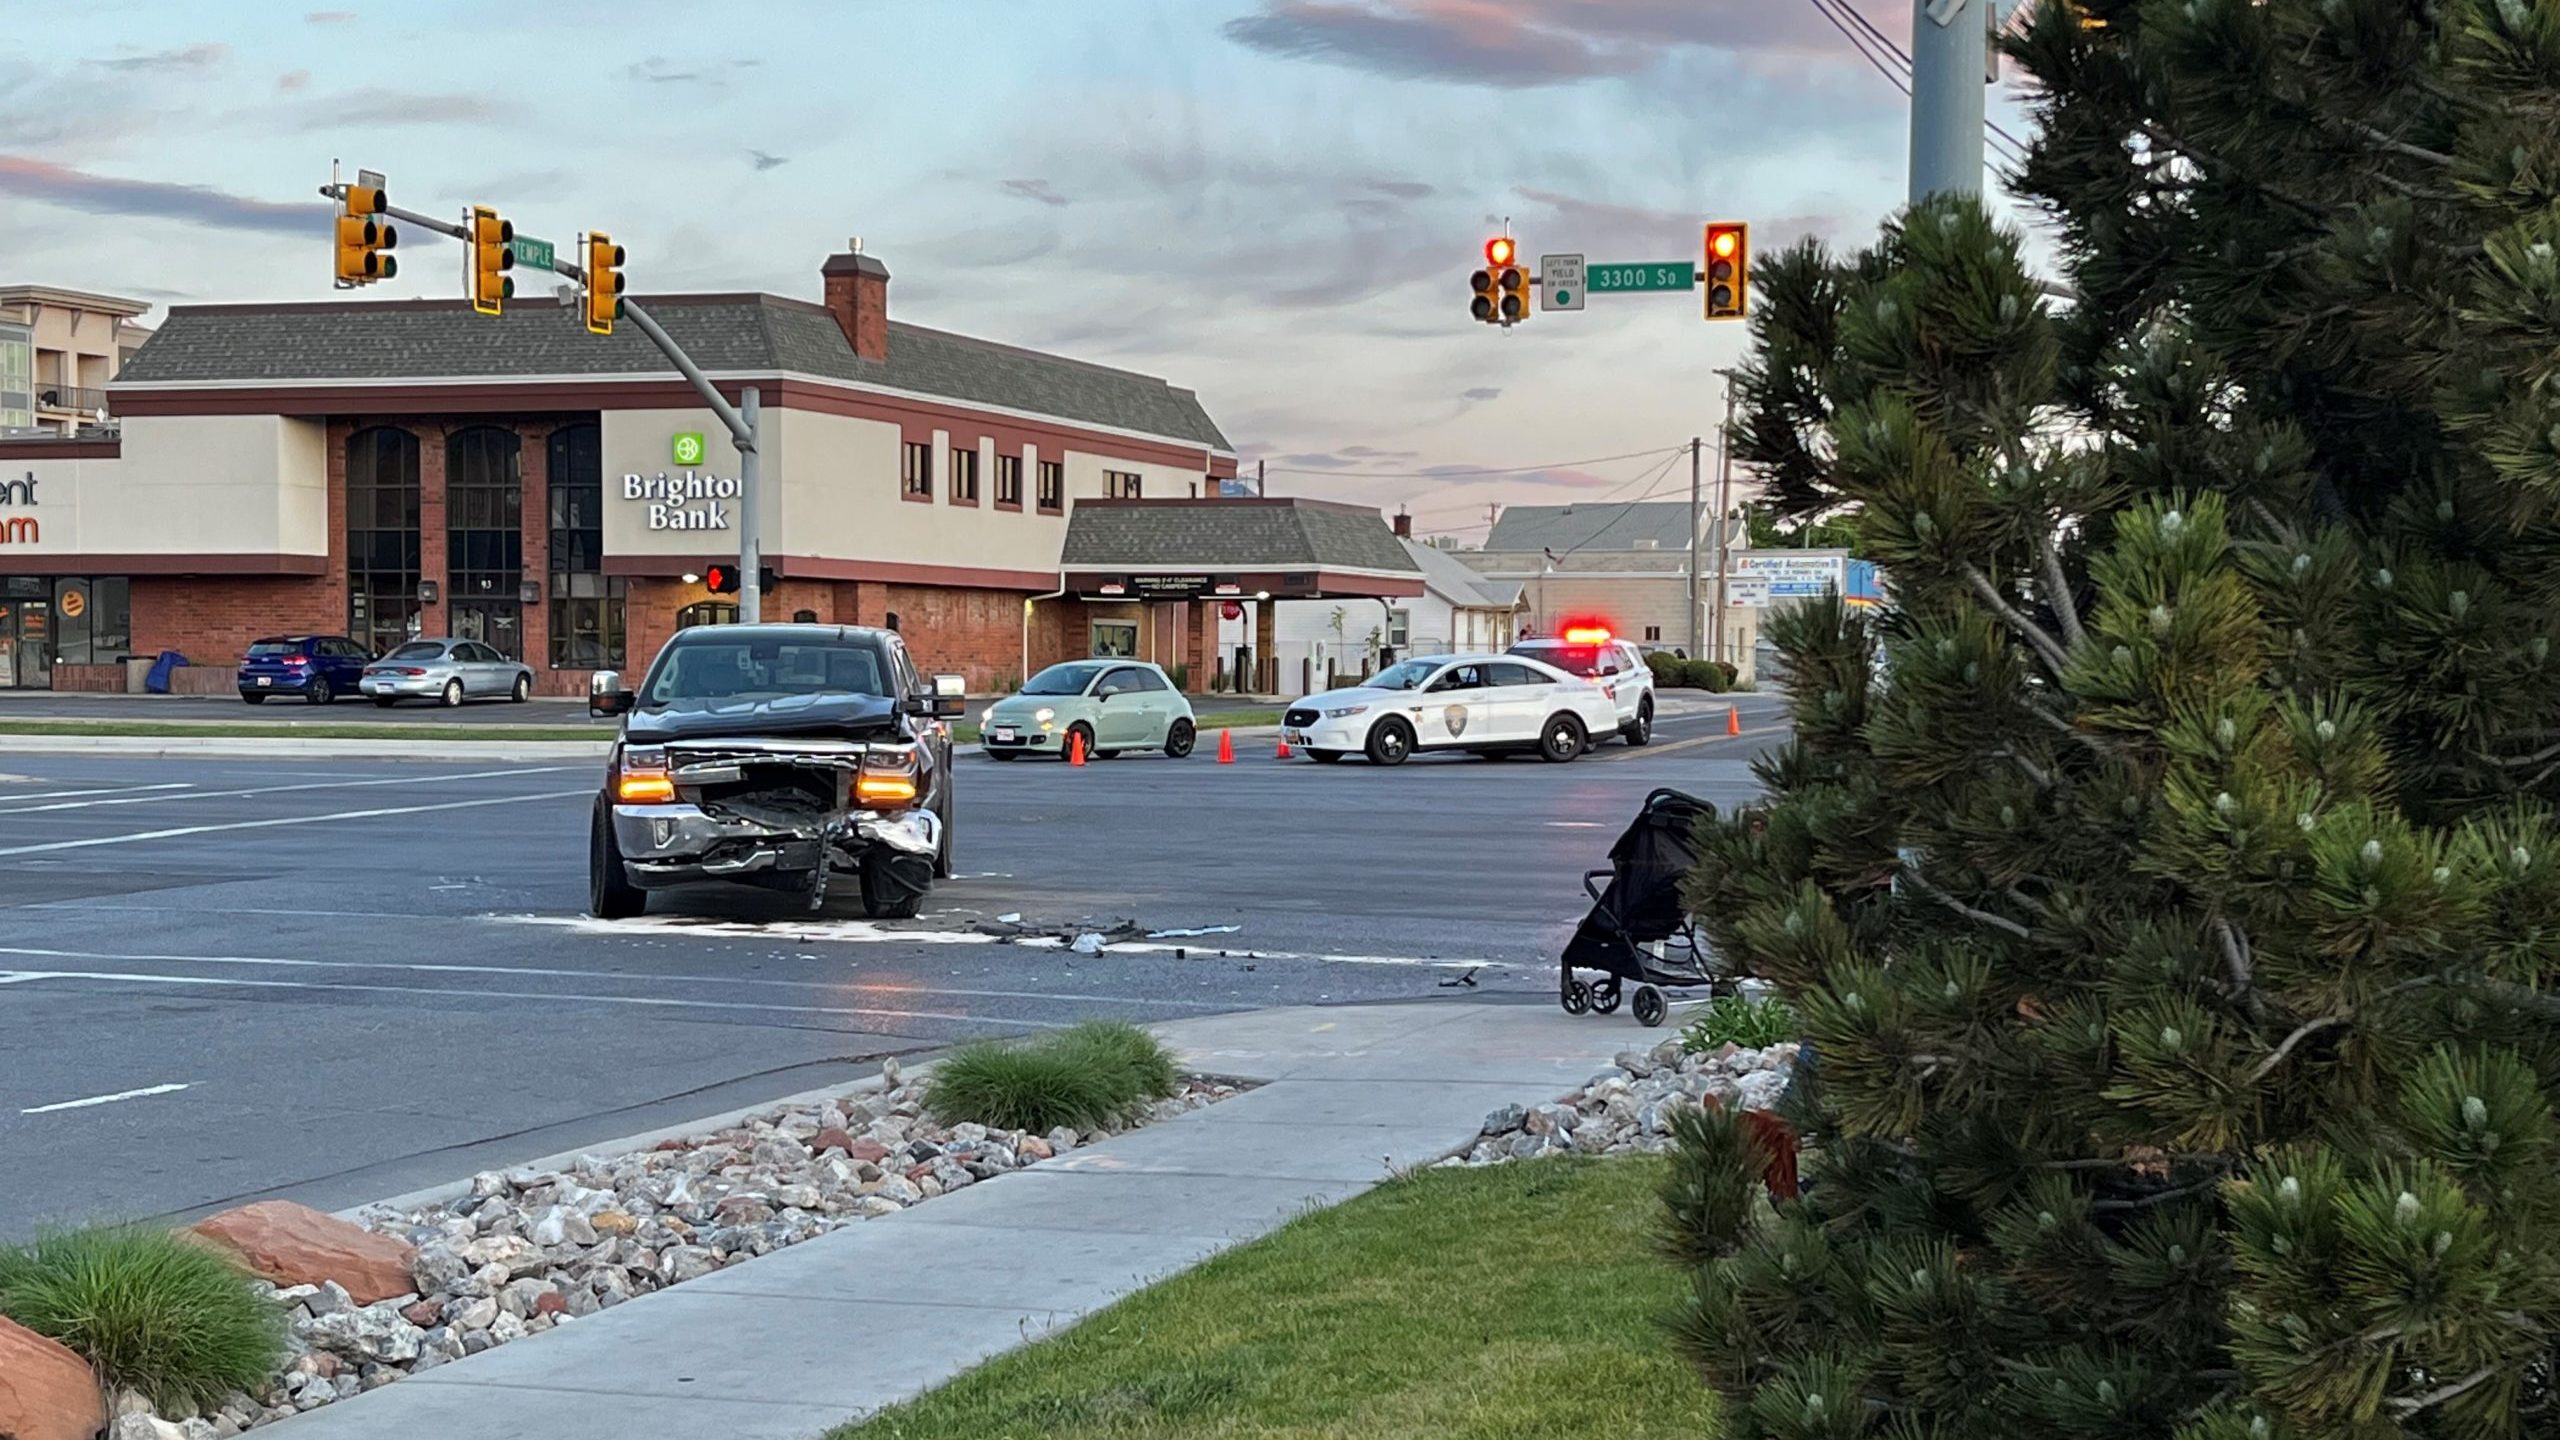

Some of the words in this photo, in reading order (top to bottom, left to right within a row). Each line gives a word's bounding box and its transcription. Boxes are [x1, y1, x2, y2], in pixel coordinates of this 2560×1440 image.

[514, 241, 551, 266] TEMPLE
[1552, 268, 1575, 278] YIELD
[1600, 269, 1646, 287] 3300
[1657, 268, 1676, 286] So
[649, 501, 729, 529] Bank
[1223, 605, 1240, 615] STOP
